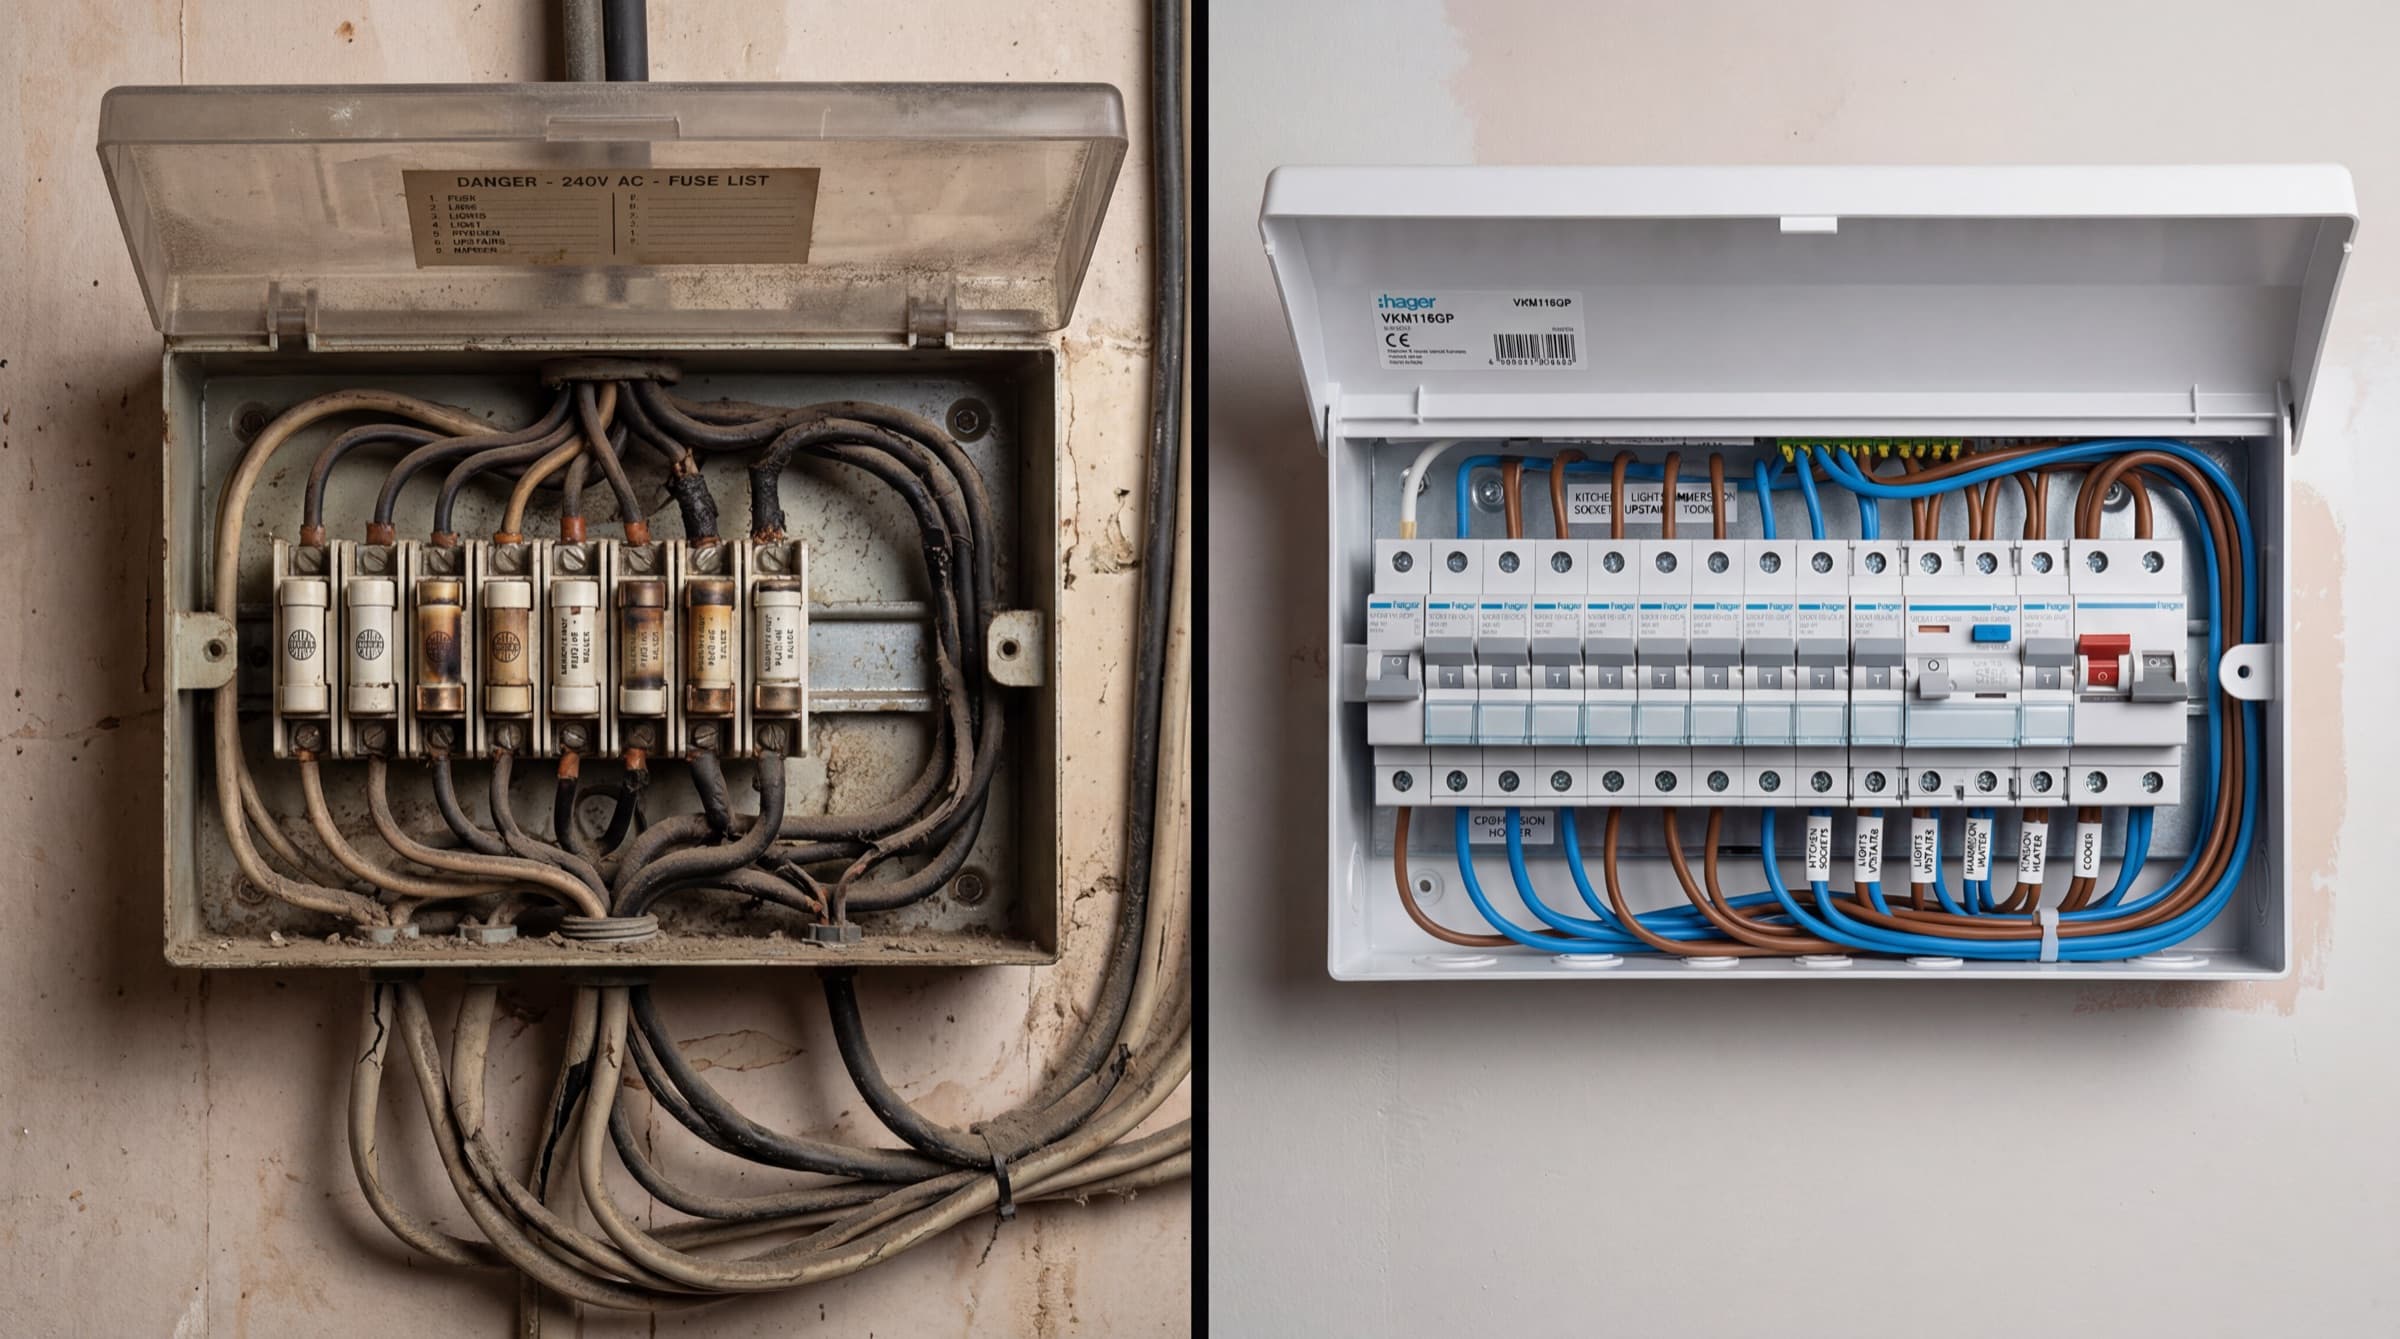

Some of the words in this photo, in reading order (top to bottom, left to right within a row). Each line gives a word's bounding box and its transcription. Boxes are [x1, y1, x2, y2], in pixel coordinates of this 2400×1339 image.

[457, 176, 537, 188] DANGER
[562, 176, 609, 187] 240V
[618, 176, 644, 187] AC
[669, 175, 719, 186] FUSE
[727, 175, 770, 186] LIST
[1382, 313, 1454, 324] VKM116GP
[1386, 333, 1410, 348] CE
[1576, 492, 1611, 502] KITCHE
[1448, 672, 1454, 682] T
[1500, 673, 1508, 682] T
[1554, 673, 1561, 682] T
[1606, 673, 1614, 683] T
[1659, 674, 1667, 684] T
[1712, 674, 1720, 684] T
[1766, 674, 1773, 684] T
[1818, 674, 1826, 684] T
[1874, 674, 1882, 684] T
[2044, 674, 2051, 684] T
[1489, 829, 1532, 838] HOER
